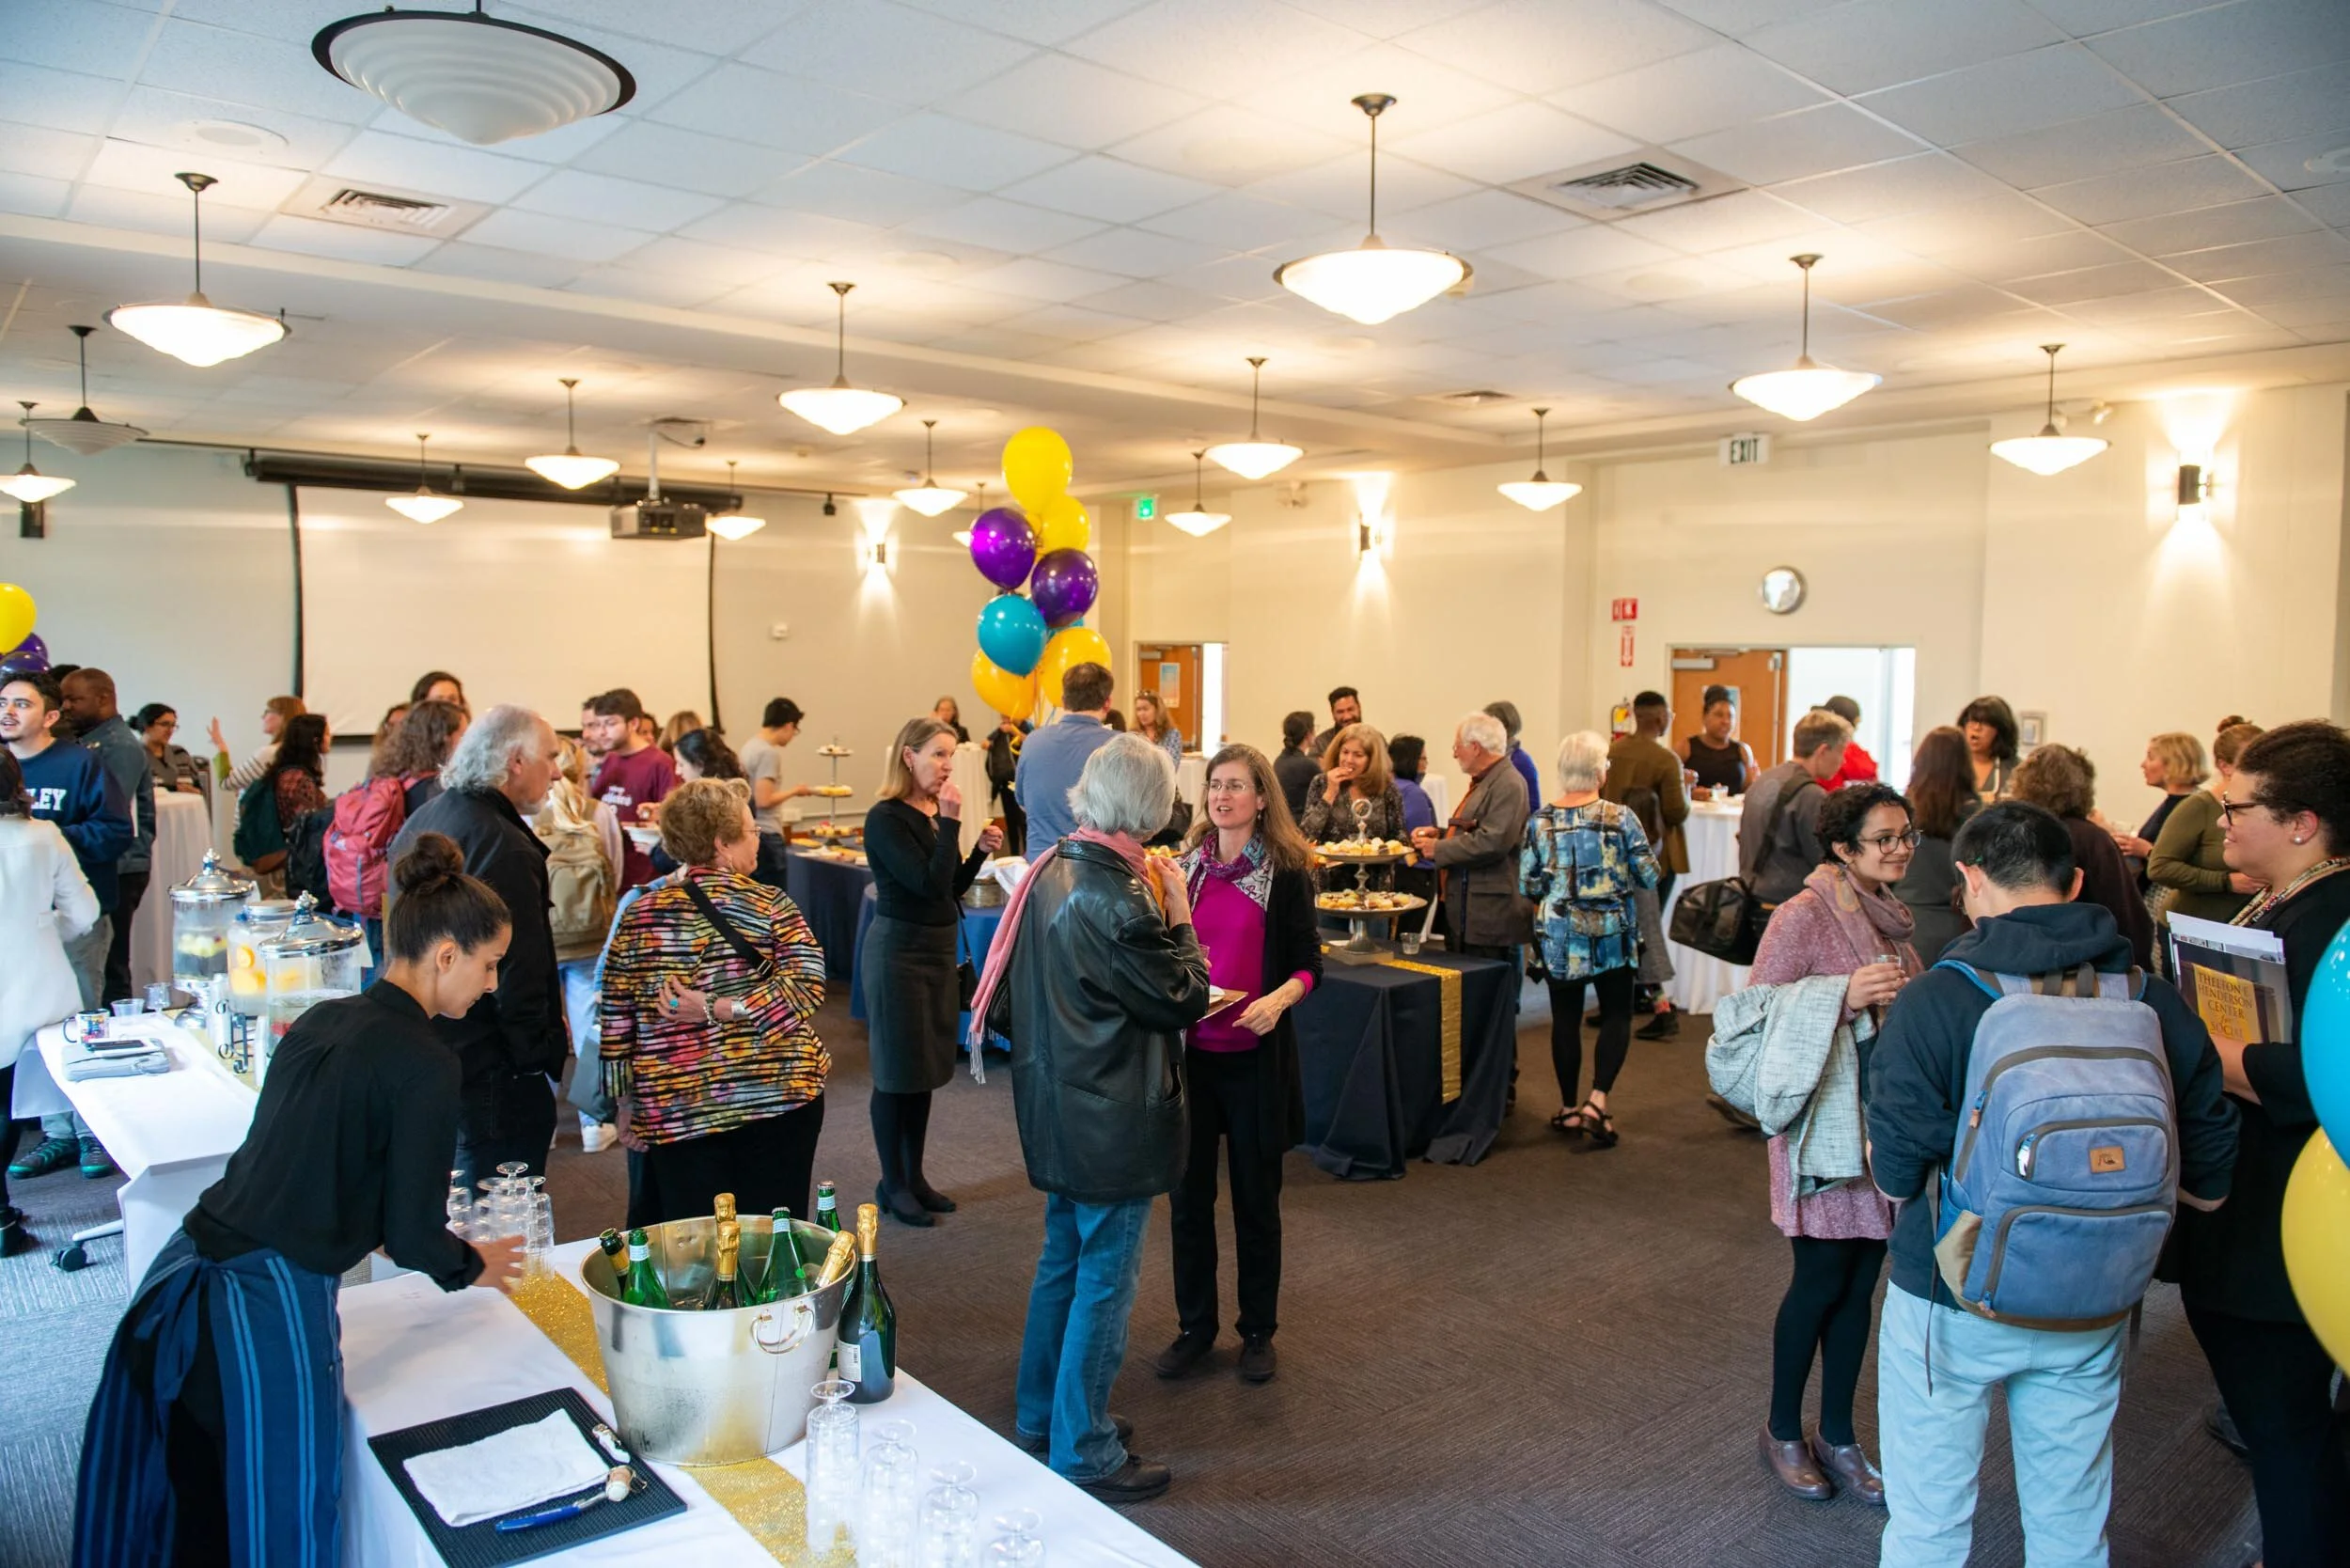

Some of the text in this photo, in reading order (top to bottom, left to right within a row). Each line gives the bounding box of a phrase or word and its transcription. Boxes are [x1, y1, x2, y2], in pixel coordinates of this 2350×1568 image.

[1730, 438, 1759, 464] EXIT
[2198, 972, 2241, 995] THELTON
[2198, 983, 2253, 1010] HENDERSON
[2207, 999, 2245, 1020] CENTER
[2210, 1021, 2244, 1039] SOCIAL
